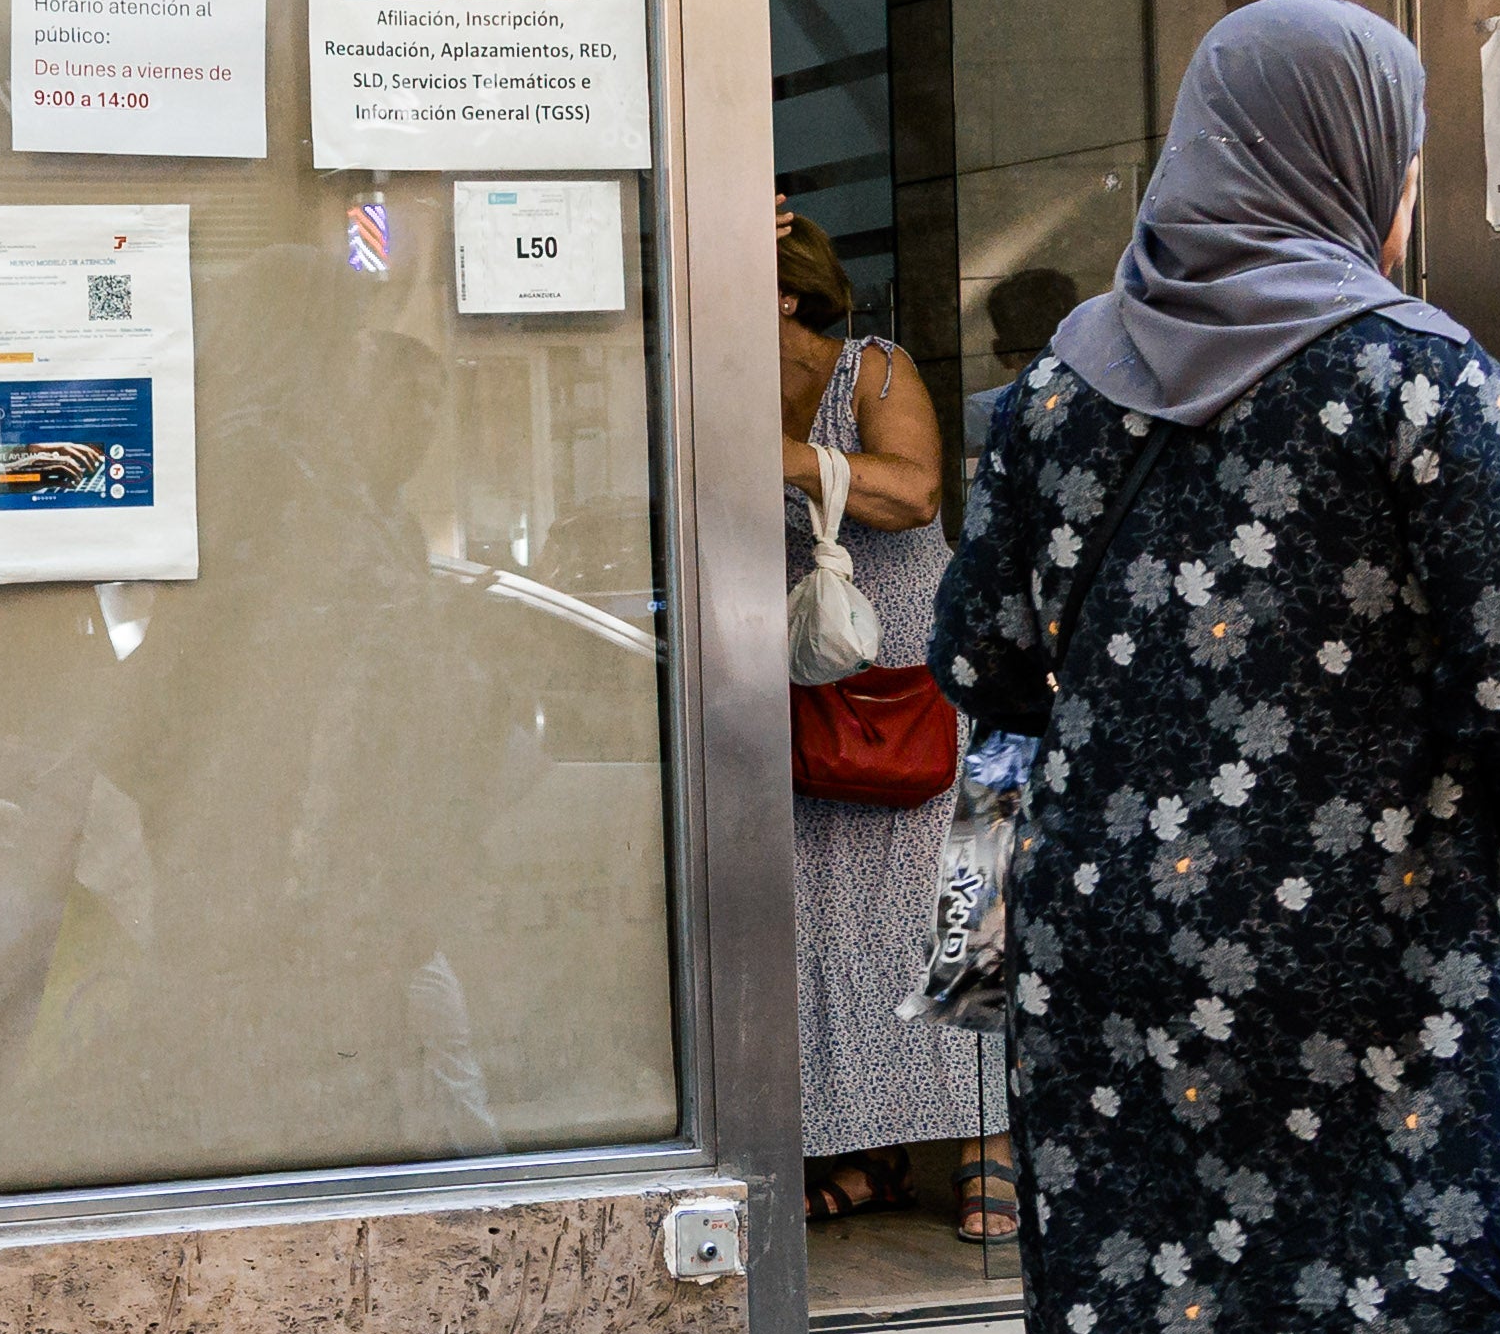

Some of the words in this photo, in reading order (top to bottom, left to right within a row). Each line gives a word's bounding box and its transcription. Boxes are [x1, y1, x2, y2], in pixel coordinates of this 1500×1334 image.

[109, 0, 190, 16] atención
[196, 1, 213, 17] al
[377, 9, 460, 28] Afiliación,
[466, 11, 564, 30] Inscripción,
[34, 26, 111, 45] público:
[325, 40, 435, 60] Recaudación,
[440, 42, 574, 61] Aplazamientos,
[580, 43, 617, 61] RED,
[35, 59, 60, 76] De
[66, 60, 116, 77] lunes
[122, 67, 132, 78] a
[137, 62, 205, 80] viernes
[209, 65, 232, 81] de
[353, 72, 387, 91] SLD,
[392, 73, 467, 90] Servicios
[472, 73, 576, 90] Telemáticos
[582, 78, 591, 90] e
[34, 90, 75, 107] 9:00
[81, 94, 91, 107] a
[98, 92, 150, 109] 14:00
[355, 104, 456, 121] Información
[462, 105, 529, 121] General
[535, 104, 590, 123] (TGSS)
[516, 236, 558, 259] L50
